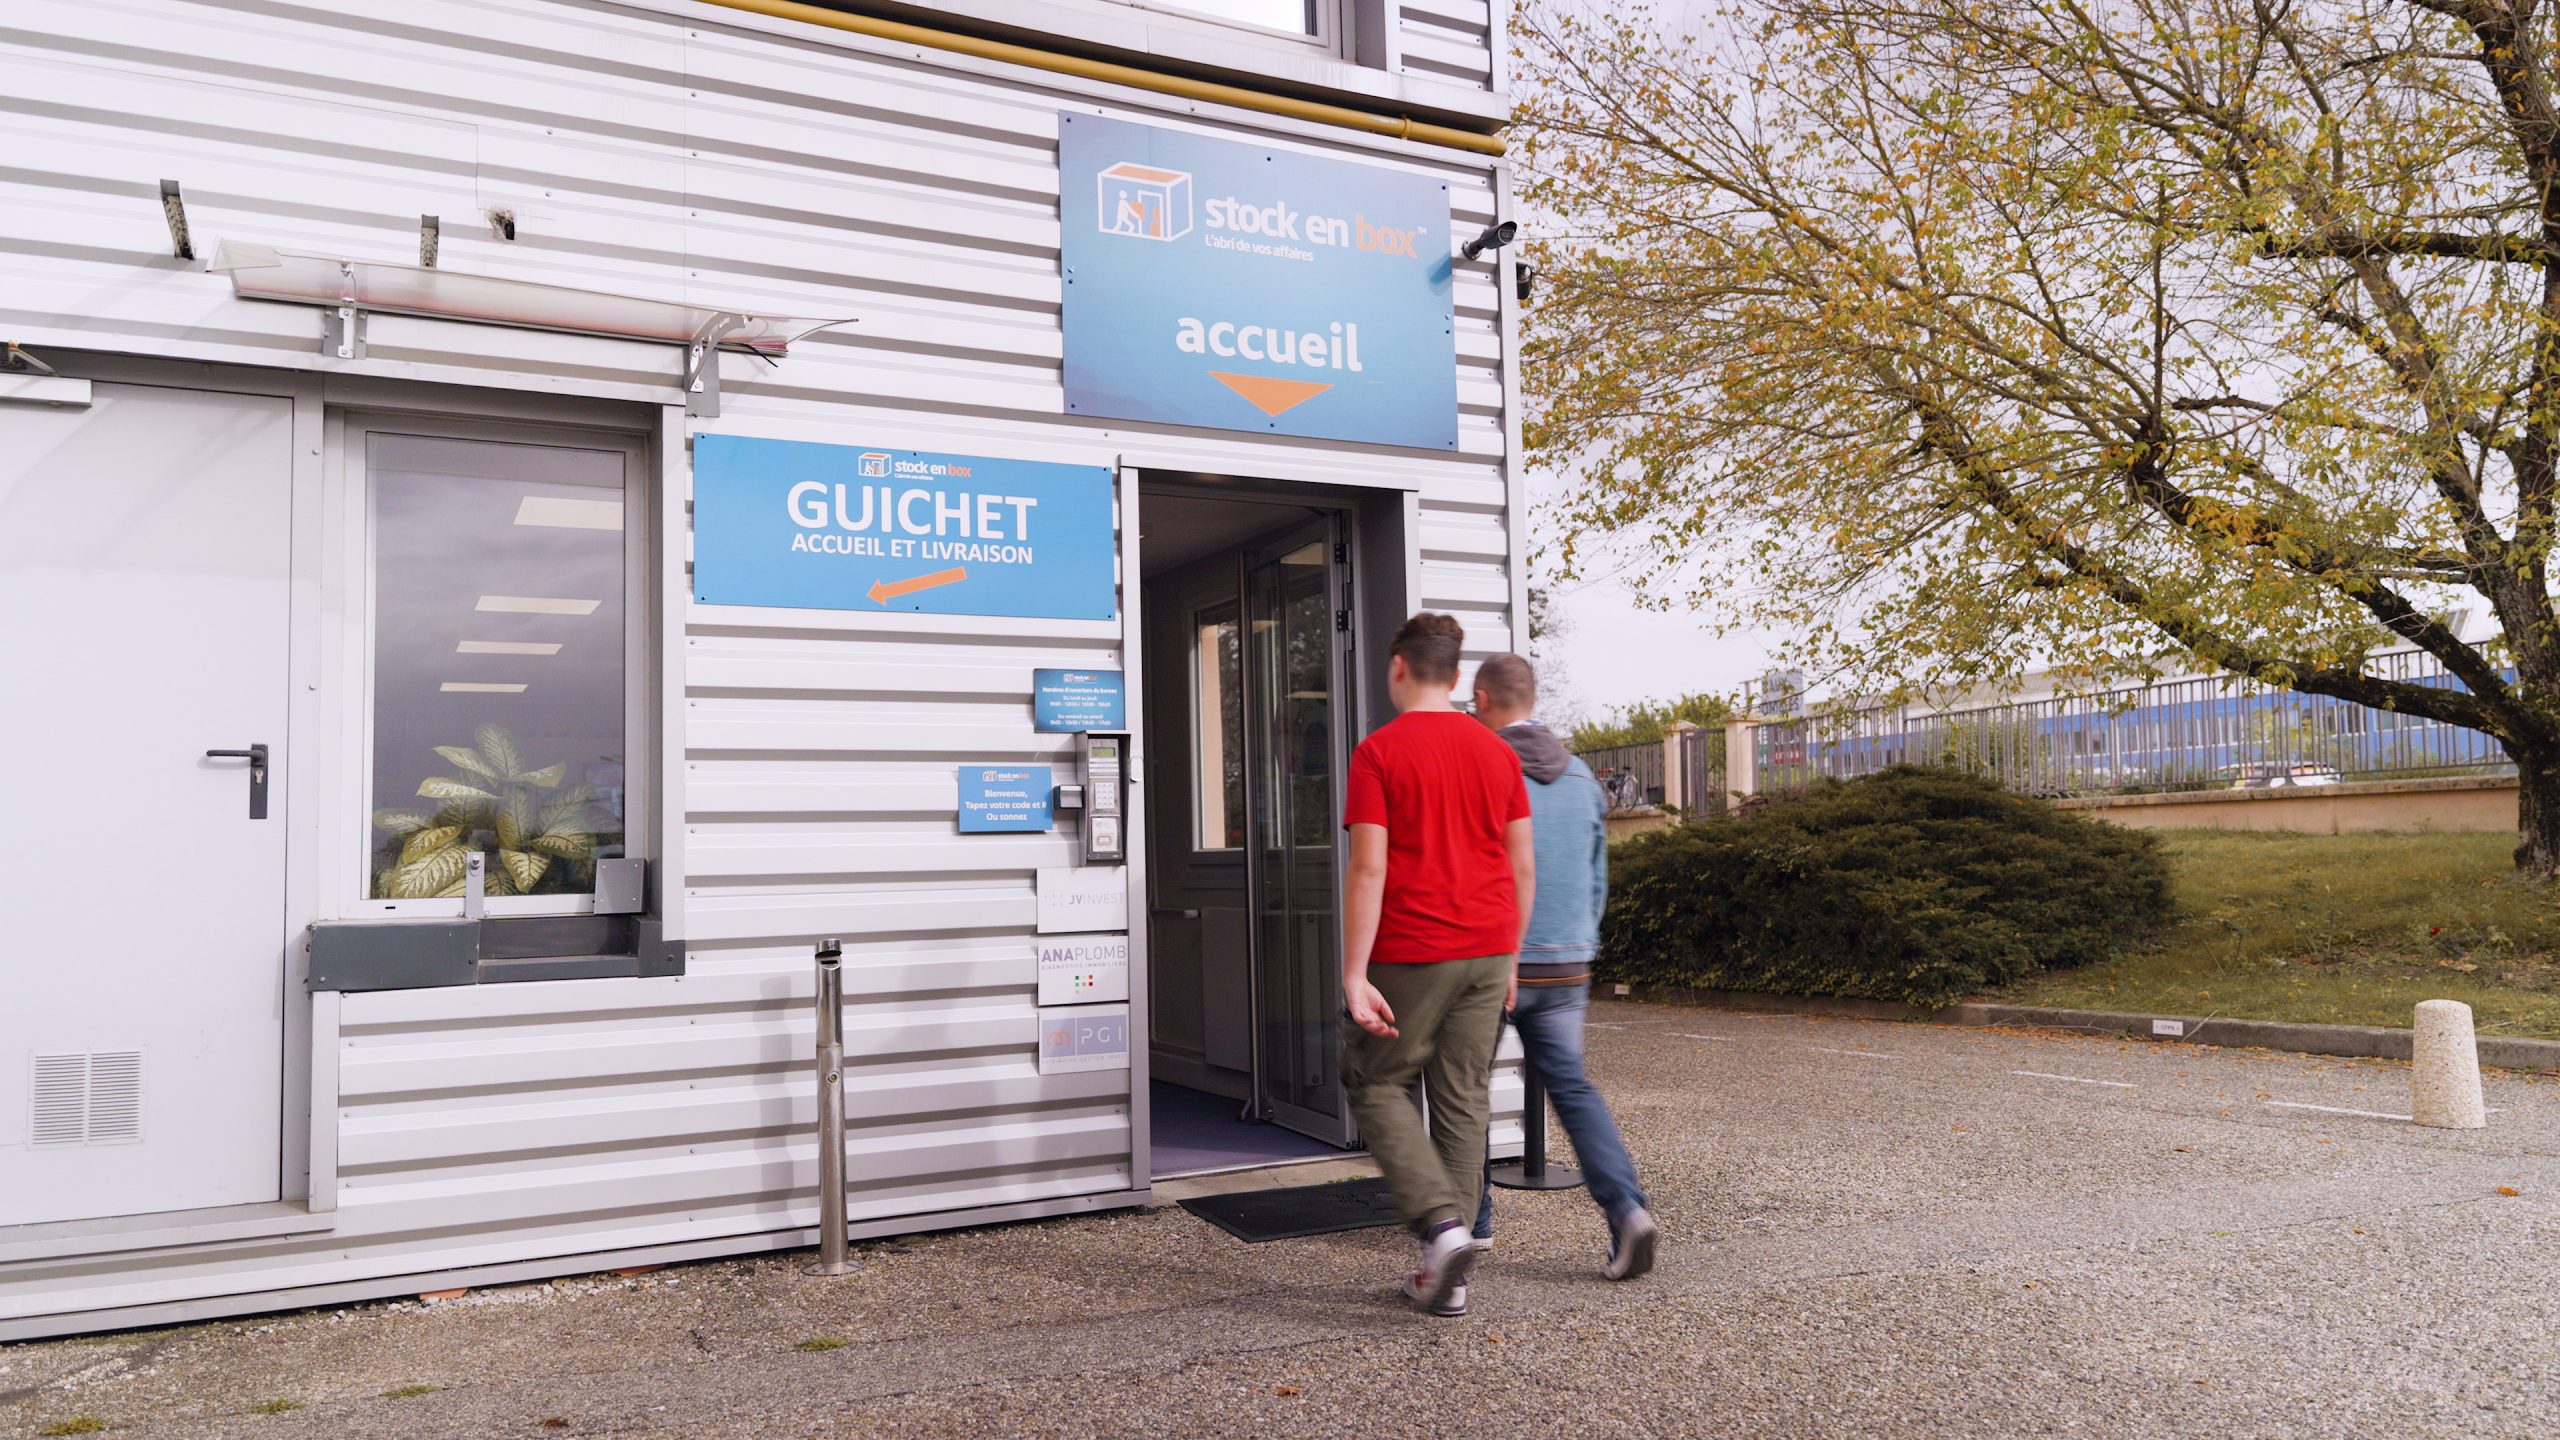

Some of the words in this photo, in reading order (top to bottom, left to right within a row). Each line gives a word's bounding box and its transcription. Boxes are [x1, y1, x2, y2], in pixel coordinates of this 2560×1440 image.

[1205, 196, 1300, 241] stock
[1305, 215, 1349, 248] en
[1205, 234, 1234, 249] L'abri
[1236, 240, 1251, 253] de
[1252, 244, 1272, 255] vos
[1273, 247, 1314, 262] affaires
[1175, 316, 1363, 372] accueil
[894, 460, 929, 474] stock
[930, 464, 947, 476] en
[947, 463, 972, 477] box
[786, 480, 1038, 541] GUICHET
[791, 533, 885, 558] ACCUEIL
[890, 540, 913, 558] ET
[921, 542, 1033, 565] LIVRAISON
[984, 789, 1028, 799] Bienvenue,
[965, 801, 987, 811] Tapez
[1012, 801, 1031, 809] code
[986, 813, 998, 821] Ou
[1041, 945, 1127, 962] ANAPLOMB
